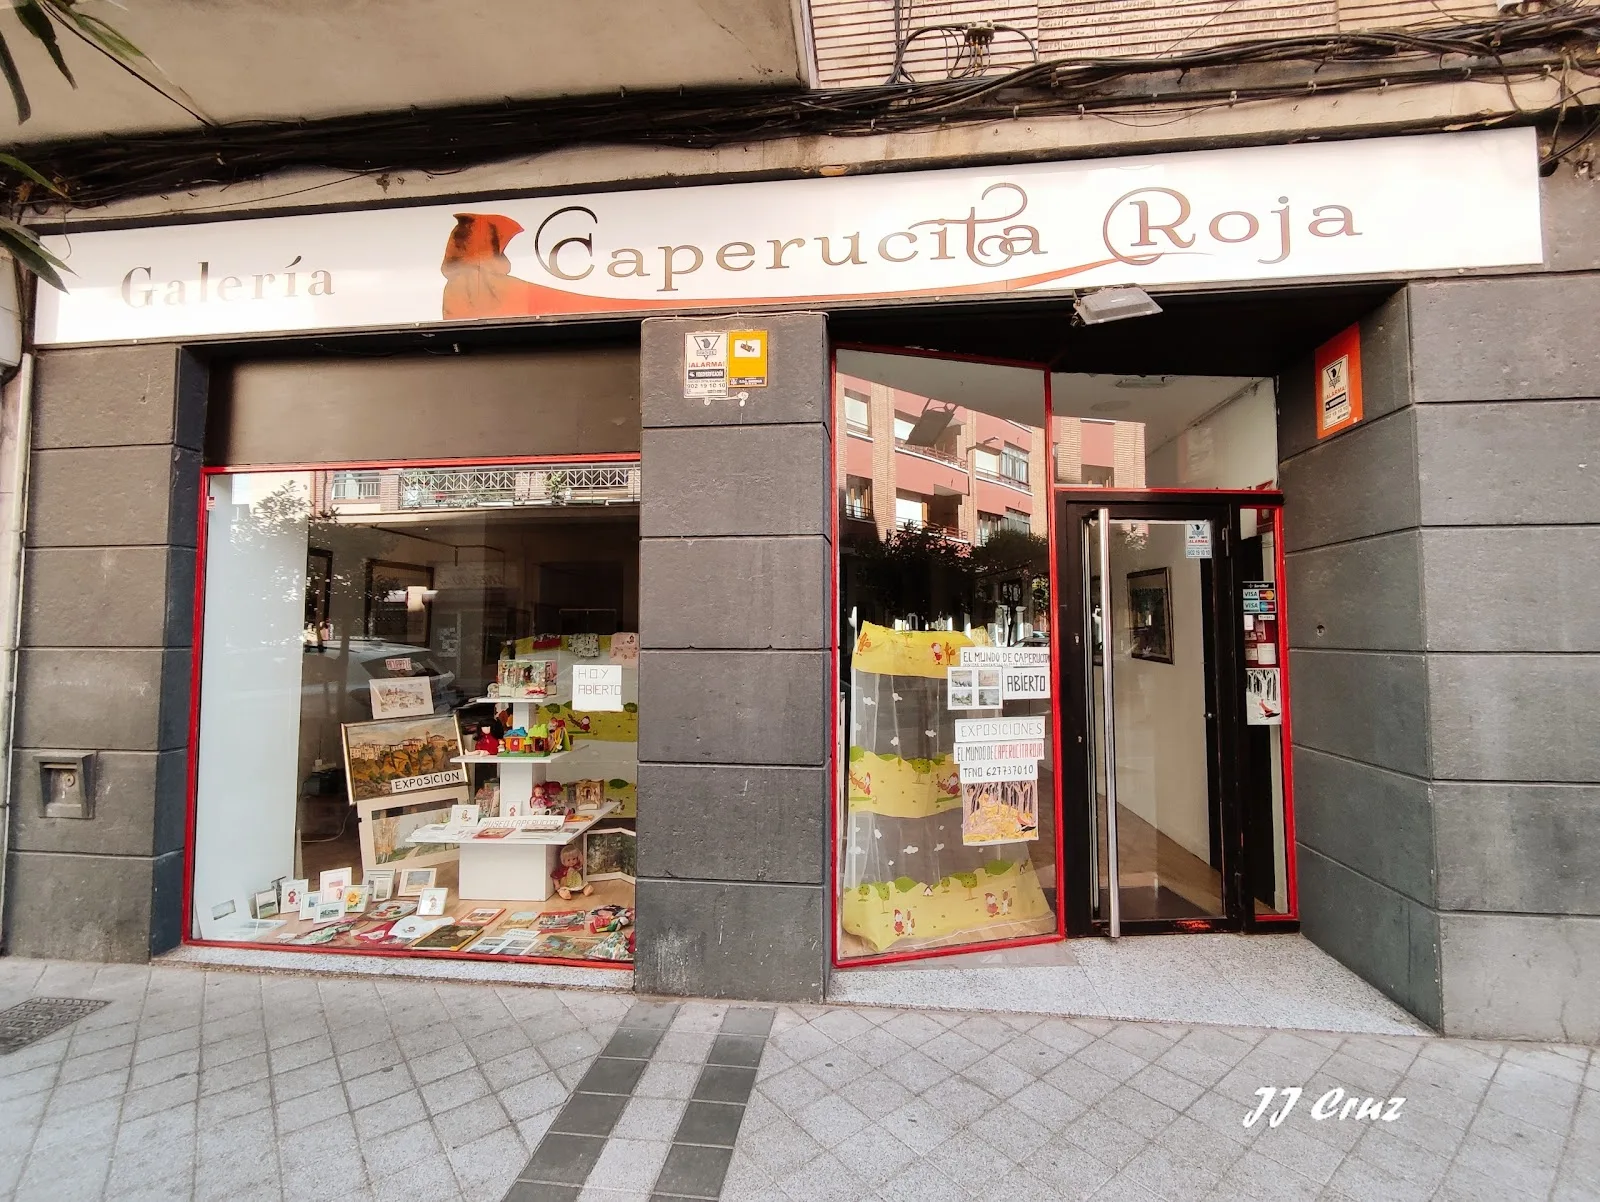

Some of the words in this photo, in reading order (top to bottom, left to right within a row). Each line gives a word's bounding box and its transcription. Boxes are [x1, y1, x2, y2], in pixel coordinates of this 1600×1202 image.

[534, 182, 1048, 292] Caperucita
[1102, 186, 1363, 266] Roja
[121, 255, 335, 309] Galería
[963, 652, 973, 663] EL
[975, 652, 1000, 663] MUNDO
[1003, 652, 1012, 663] DE
[579, 669, 609, 679] HOY
[1007, 673, 1046, 692] ABIERTO
[578, 684, 621, 695] ABIERTO
[961, 722, 1042, 738] EXPOSICIONES
[394, 772, 460, 790] EXPOSICION
